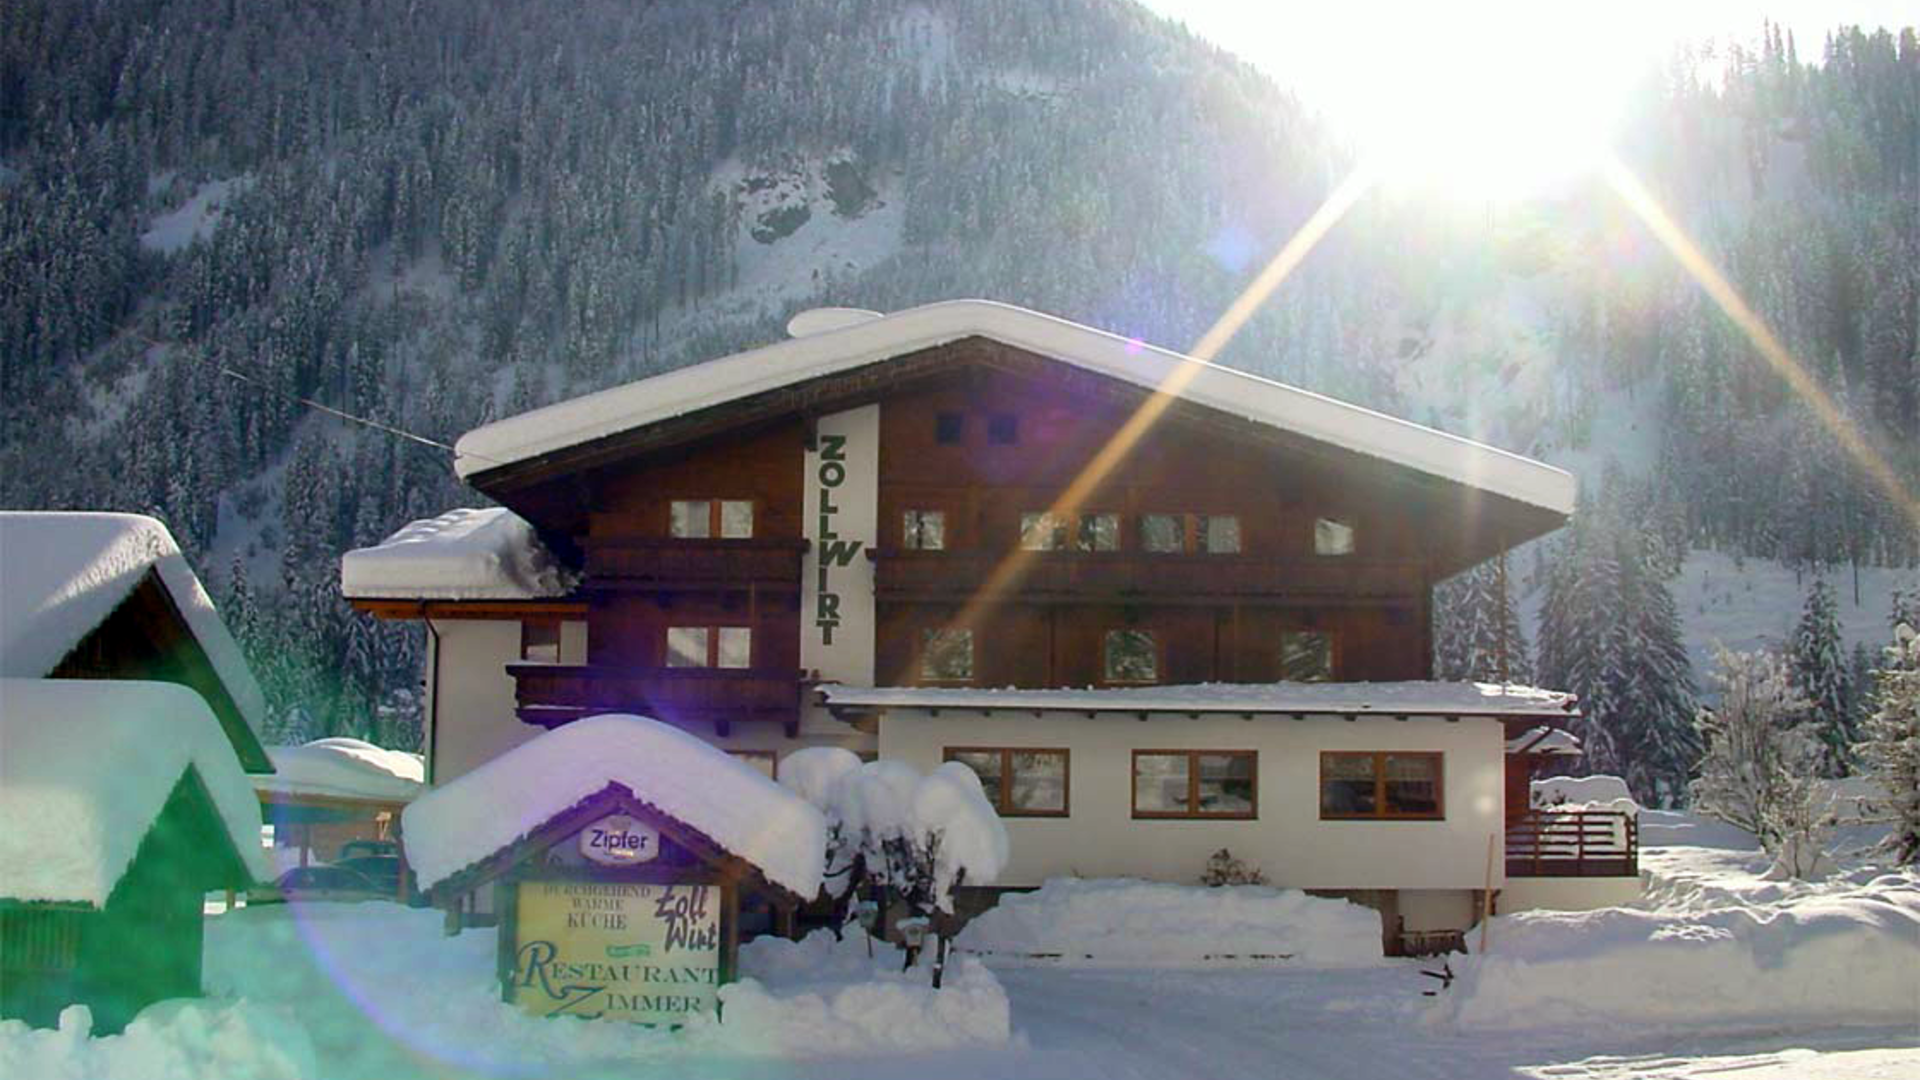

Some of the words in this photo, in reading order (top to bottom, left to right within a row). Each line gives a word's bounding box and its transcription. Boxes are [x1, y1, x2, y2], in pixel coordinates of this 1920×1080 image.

[816, 435, 863, 645] ZOLLWIRT
[590, 829, 648, 850] Zipfer
[664, 914, 717, 953] Wirt
[519, 940, 719, 999] RESTAURANT
[545, 985, 701, 1020] ZIMMER
